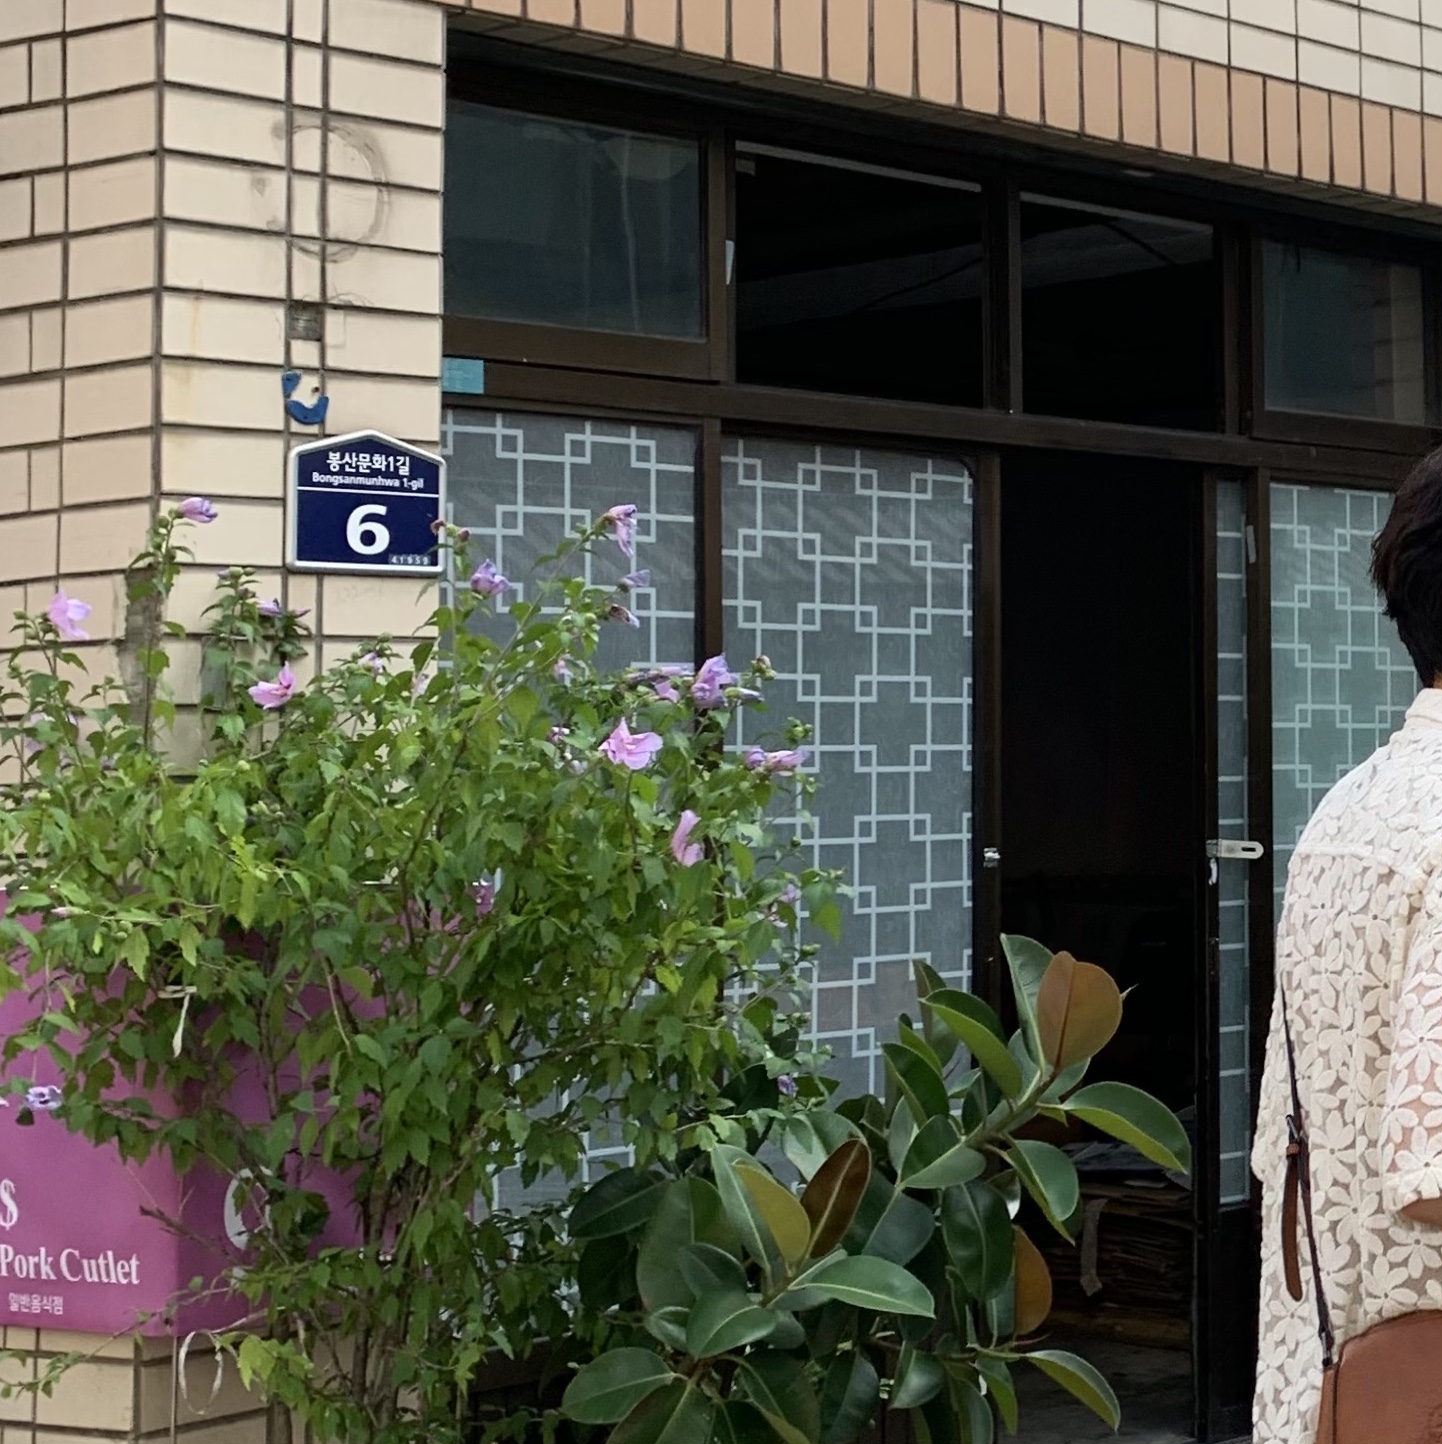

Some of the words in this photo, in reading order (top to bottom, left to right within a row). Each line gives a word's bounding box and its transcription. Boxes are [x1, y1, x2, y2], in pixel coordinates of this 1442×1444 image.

[326, 451, 410, 475] 봉산문화1길
[312, 472, 400, 487] Bongsanmunhwa
[403, 478, 424, 490] 1-gil
[346, 504, 390, 555] 6
[0, 1244, 57, 1281] Pork
[59, 1248, 141, 1285] Cutlet
[8, 1292, 64, 1316] 일반음식점
